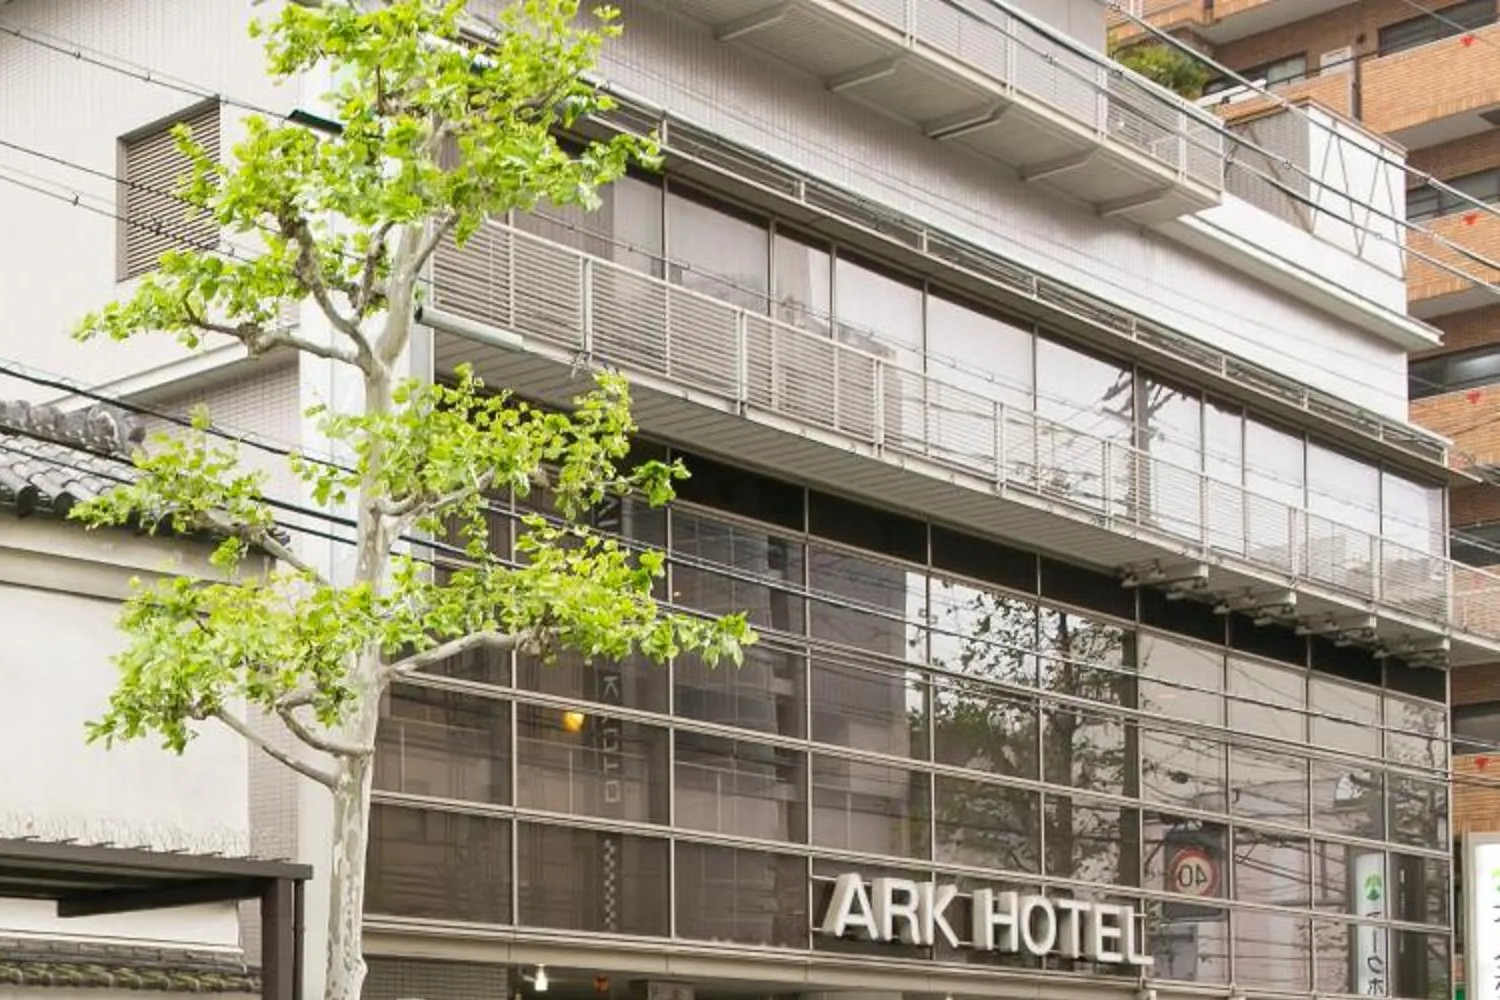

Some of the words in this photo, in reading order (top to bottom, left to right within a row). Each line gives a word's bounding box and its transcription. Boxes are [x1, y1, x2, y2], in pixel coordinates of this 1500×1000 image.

[603, 676, 621, 803] KOTO
[822, 872, 959, 948] ARK
[972, 888, 1155, 965] HOTEL
